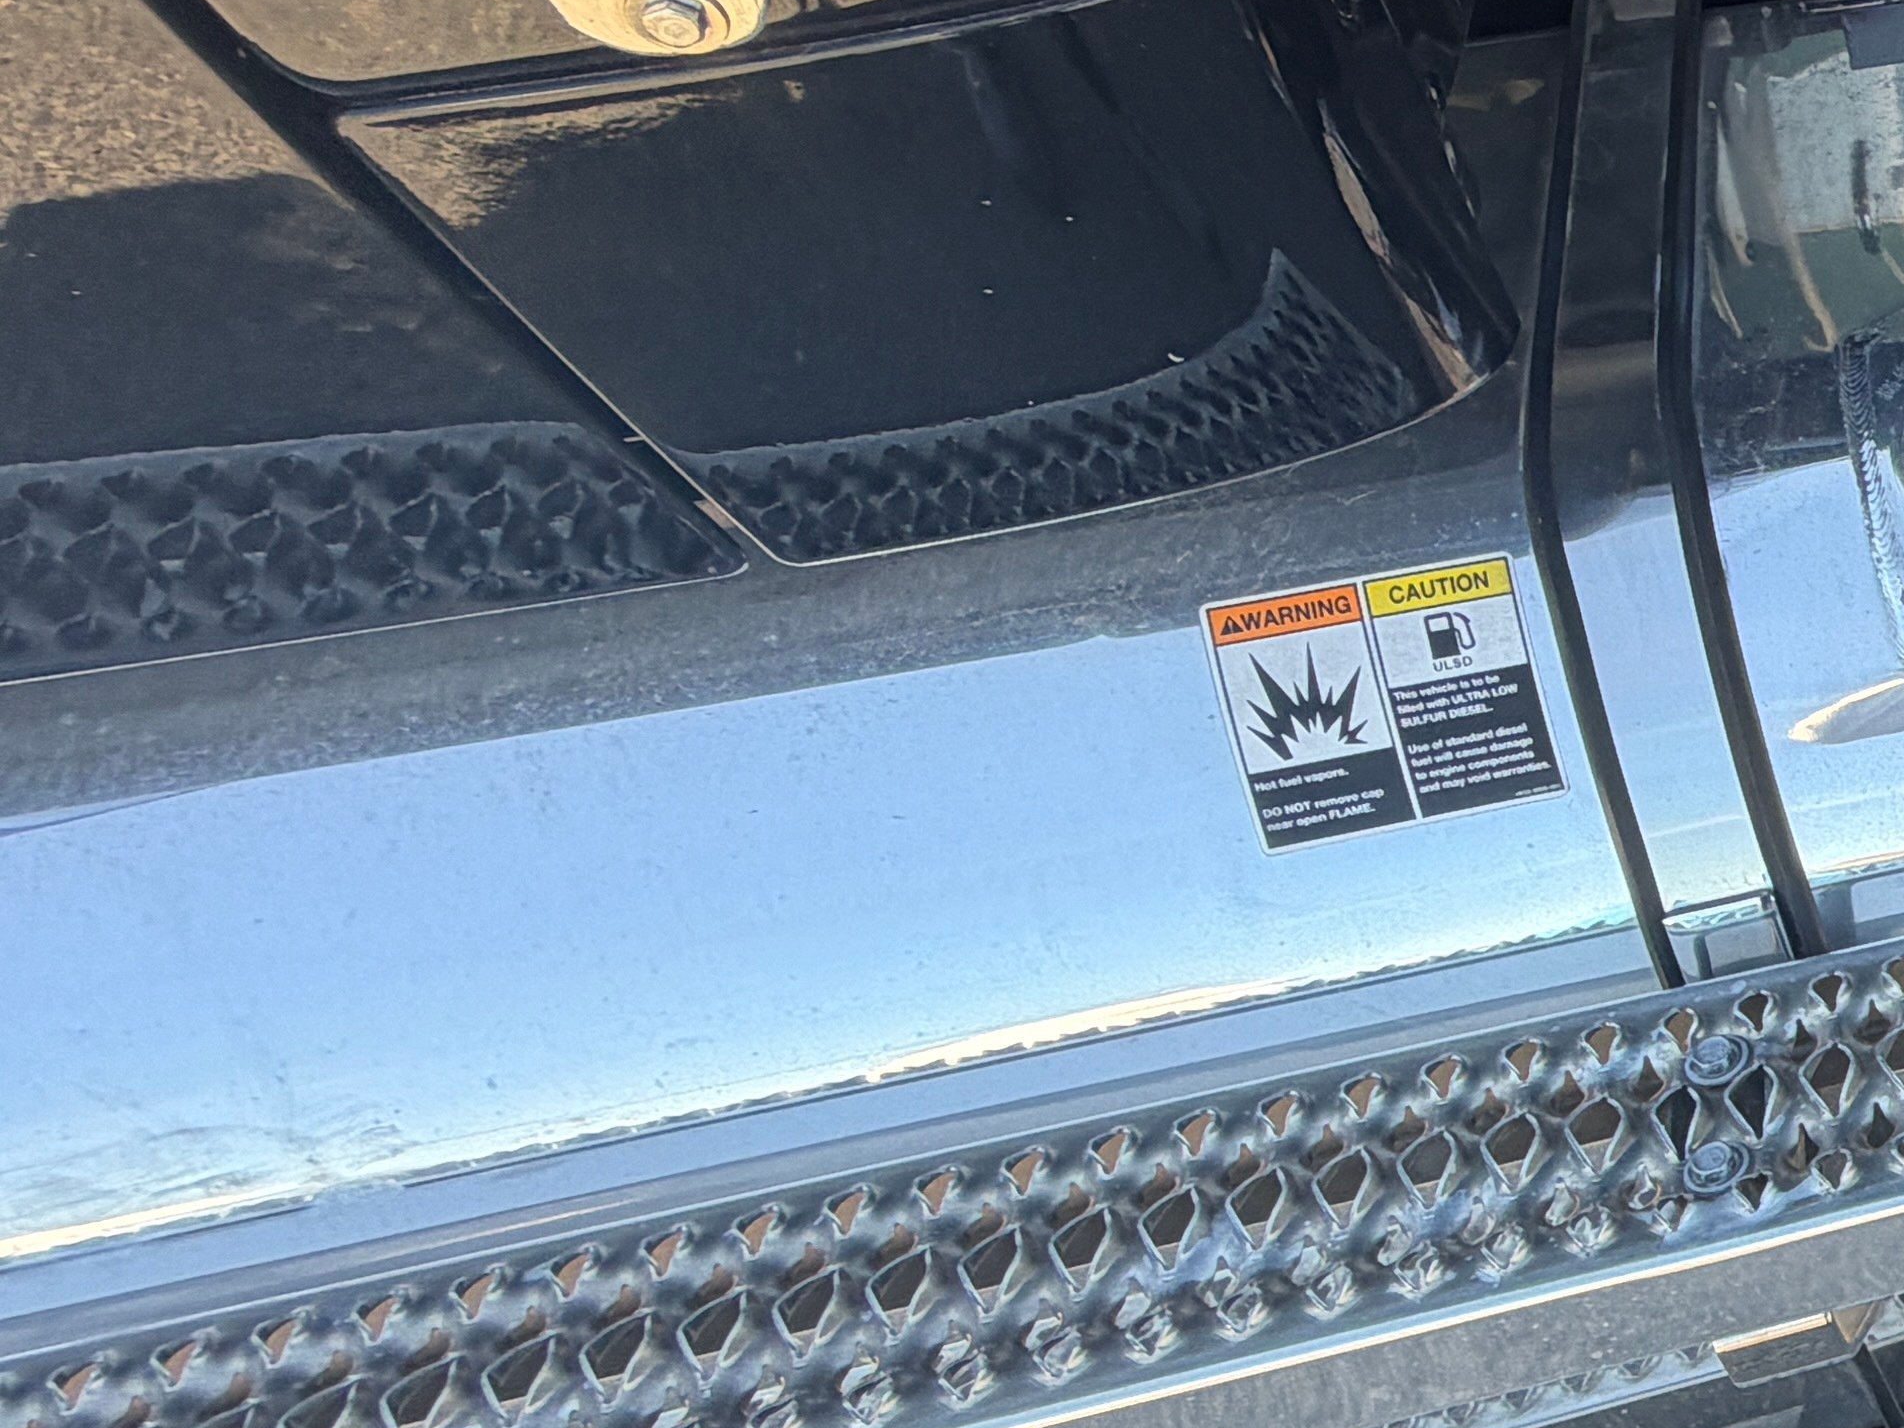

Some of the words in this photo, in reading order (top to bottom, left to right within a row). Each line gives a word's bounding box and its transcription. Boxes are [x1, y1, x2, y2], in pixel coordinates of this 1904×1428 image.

[1388, 570, 1490, 606] CAUTION
[1240, 595, 1352, 631] WARNING
[1432, 655, 1473, 673] ULSD
[1393, 690, 1418, 702] This
[1419, 682, 1459, 696] vehicle
[1459, 679, 1471, 690] is
[1471, 677, 1484, 687] to
[1485, 674, 1500, 684] be
[1426, 697, 1450, 709] with
[1450, 688, 1491, 705] ULTRA
[1491, 683, 1518, 698] LOW
[1400, 711, 1448, 728] SULFUR
[1407, 743, 1430, 754] Use
[1431, 738, 1443, 750] of
[1411, 756, 1433, 767] fuel
[1278, 775, 1302, 788] fuel
[1415, 770, 1427, 780] to
[1419, 782, 1440, 794] and
[1441, 778, 1466, 790] may
[1466, 771, 1491, 784] void
[1262, 806, 1283, 819] DO
[1284, 800, 1312, 815] NOT
[1313, 793, 1359, 810] remove
[1360, 788, 1385, 800] cap
[1267, 820, 1294, 832] near
[1296, 814, 1328, 828] open
[1328, 802, 1376, 820] FLAME.
